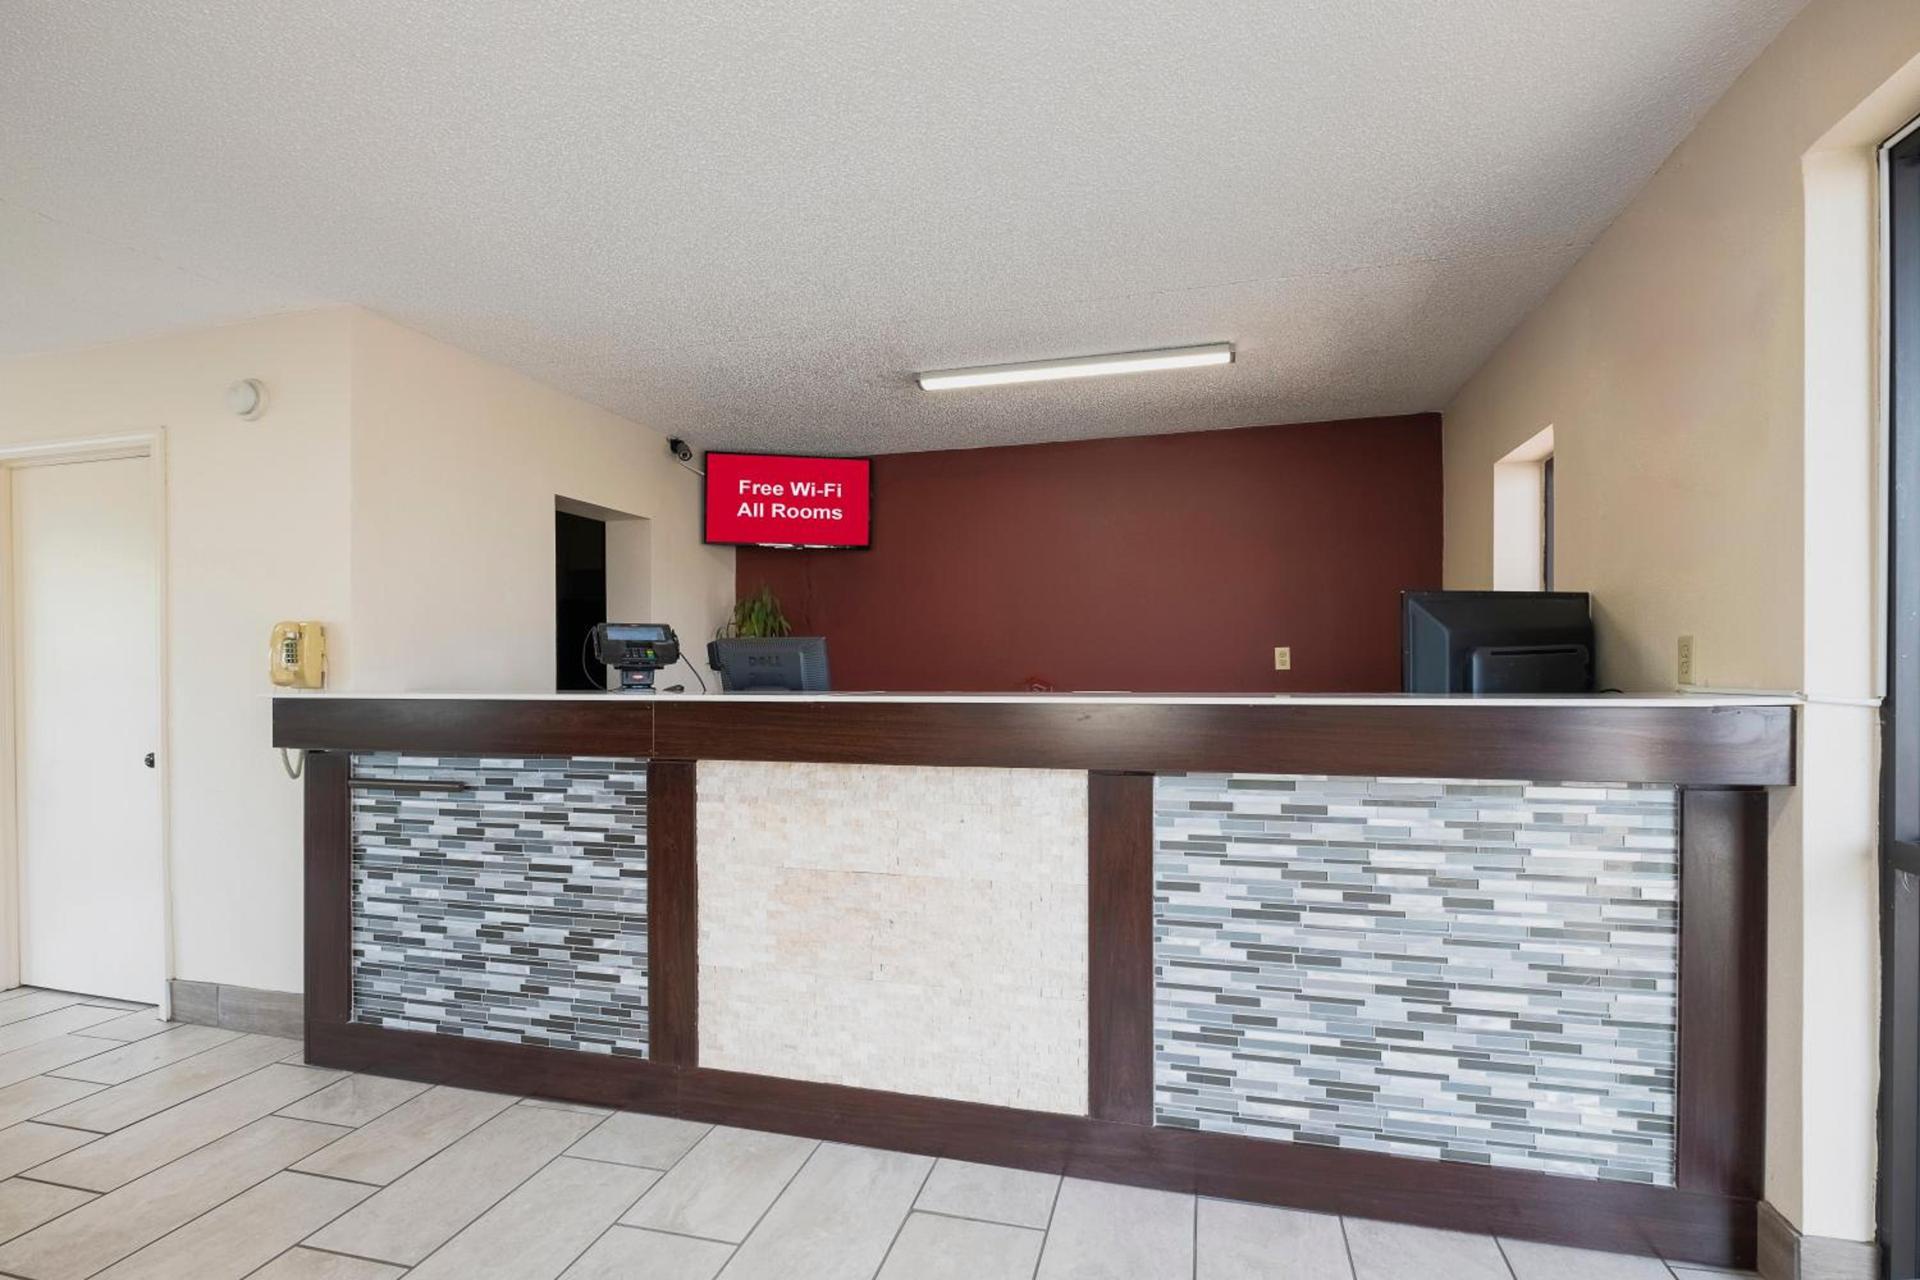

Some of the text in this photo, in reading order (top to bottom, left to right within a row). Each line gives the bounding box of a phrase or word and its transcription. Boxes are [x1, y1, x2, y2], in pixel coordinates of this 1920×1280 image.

[739, 479, 842, 498] Free Wi-Fi
[736, 502, 843, 521] All Rooms
[748, 655, 783, 667] DELL
